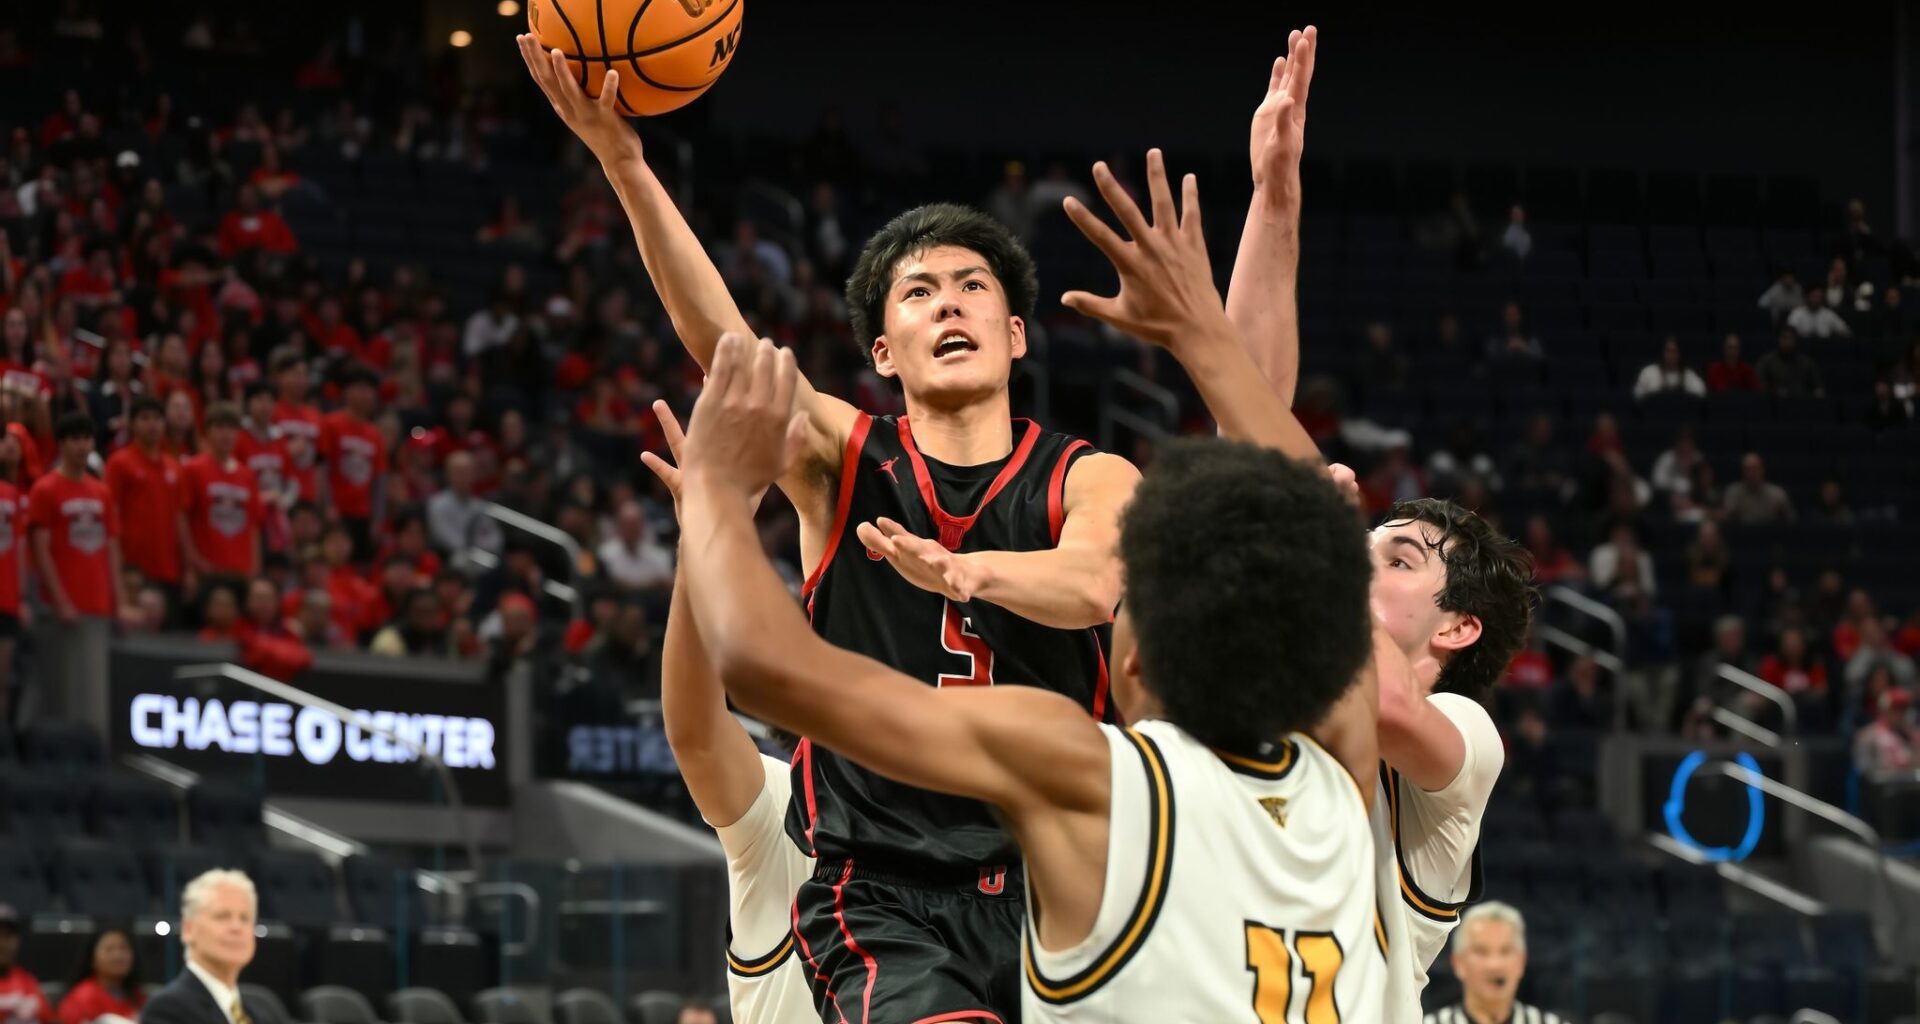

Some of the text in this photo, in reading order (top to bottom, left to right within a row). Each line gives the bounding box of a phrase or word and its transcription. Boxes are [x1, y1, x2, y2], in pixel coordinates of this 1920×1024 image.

[130, 693, 496, 770] CHASE CENTER
[1244, 919, 1345, 1024] 11
